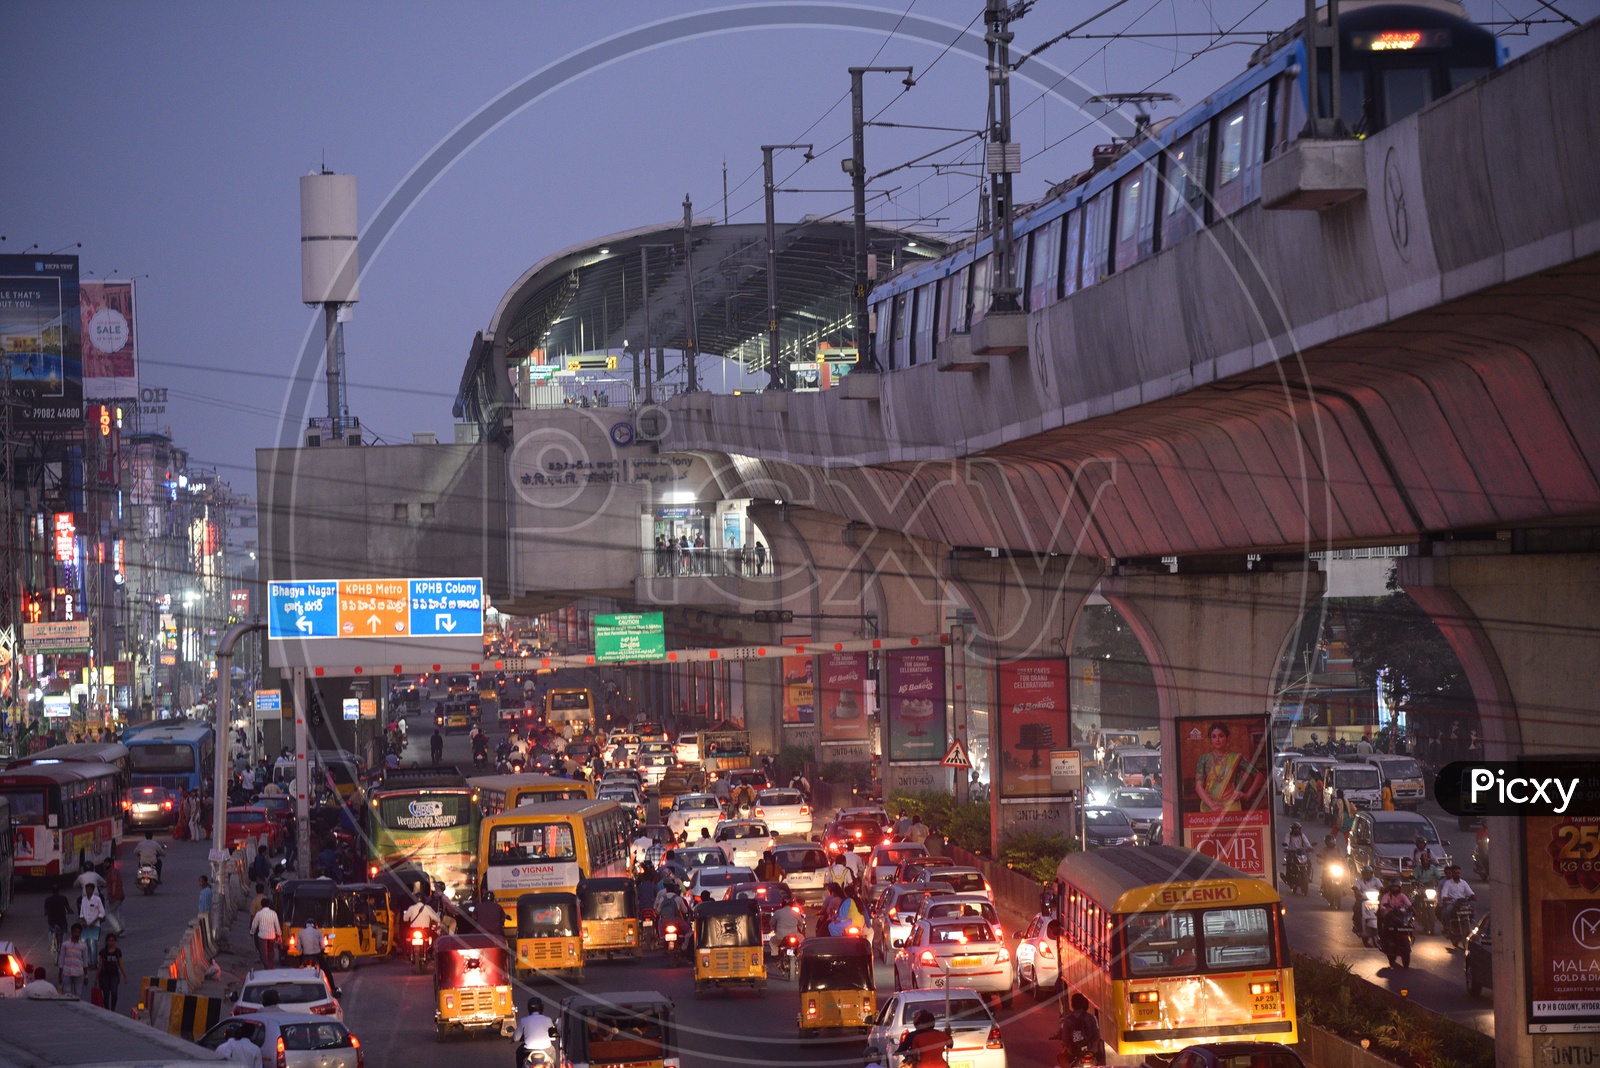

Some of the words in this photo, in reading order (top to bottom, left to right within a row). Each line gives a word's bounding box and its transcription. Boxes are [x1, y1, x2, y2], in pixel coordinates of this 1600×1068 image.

[13, 291, 41, 299] THAT'S
[97, 326, 121, 334] SALE
[57, 408, 79, 418] 44800
[660, 457, 693, 467] Colony
[272, 585, 305, 598] Bhagya
[308, 585, 335, 598] Nagar
[345, 584, 372, 595] KPHB
[375, 584, 402, 594] Metro
[415, 583, 442, 593] KPHB
[445, 582, 476, 595] Colony
[397, 815, 433, 826] Veerabhadra
[434, 815, 456, 825] Swamy
[1558, 825, 1600, 859] 25
[1196, 837, 1258, 860] CMR
[521, 866, 554, 874] VIGNAN
[1560, 861, 1577, 871] KG
[1162, 887, 1232, 904] ELLENKI
[1553, 974, 1578, 982] GOLD
[1138, 1008, 1154, 1016] STOP
[1558, 1003, 1580, 1012] COLONY,
[1581, 1002, 1600, 1010] HYDER
